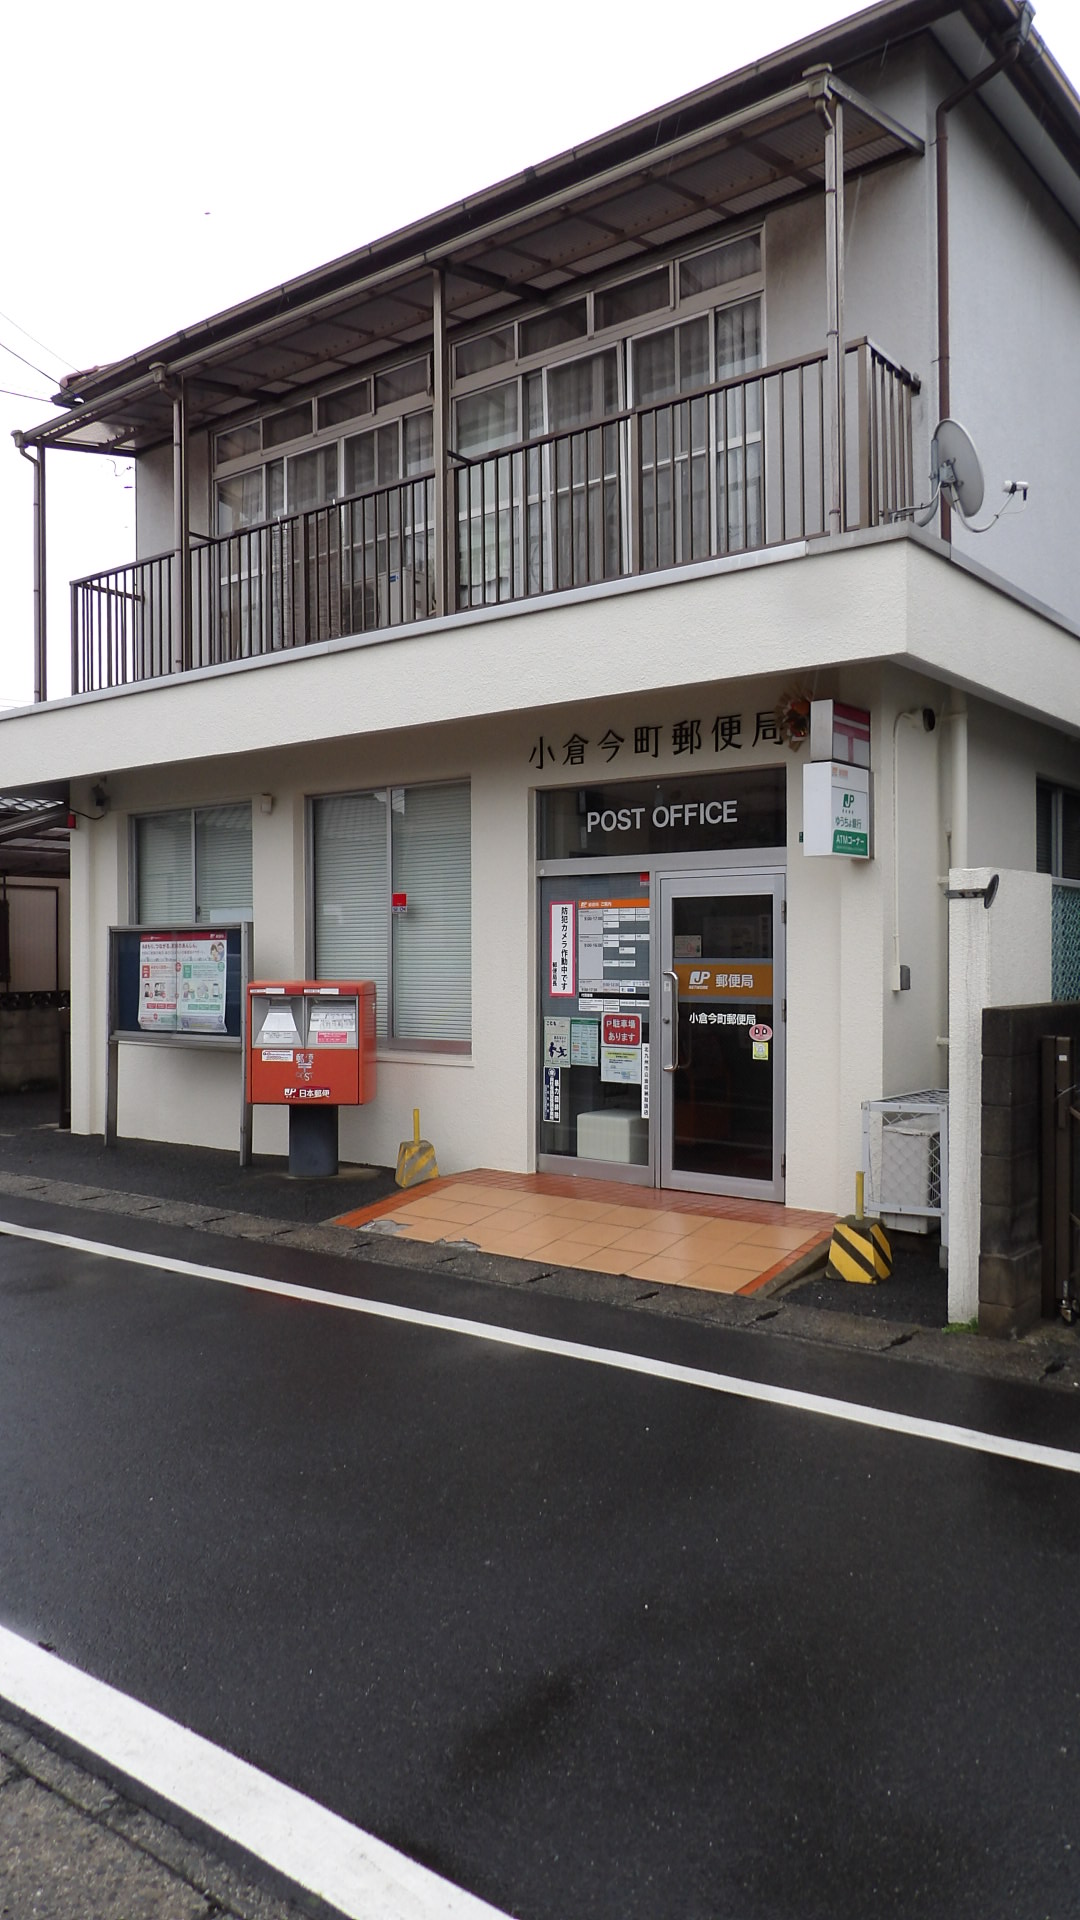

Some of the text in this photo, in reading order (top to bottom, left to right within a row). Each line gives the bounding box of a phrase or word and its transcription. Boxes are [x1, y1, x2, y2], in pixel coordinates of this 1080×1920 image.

[528, 711, 783, 770] 小倉今町郵便局
[586, 800, 738, 833] POST OFFICE
[835, 816, 862, 830] ゆうちょ銀行
[836, 834, 865, 846] ATMコーナー
[561, 906, 569, 991] 防犯カメラ作動中です
[689, 971, 753, 988] JP 郵便局
[689, 1012, 756, 1025] 小倉今町郵便局
[608, 1032, 635, 1042] あります
[299, 1089, 330, 1098] 日本郵便
